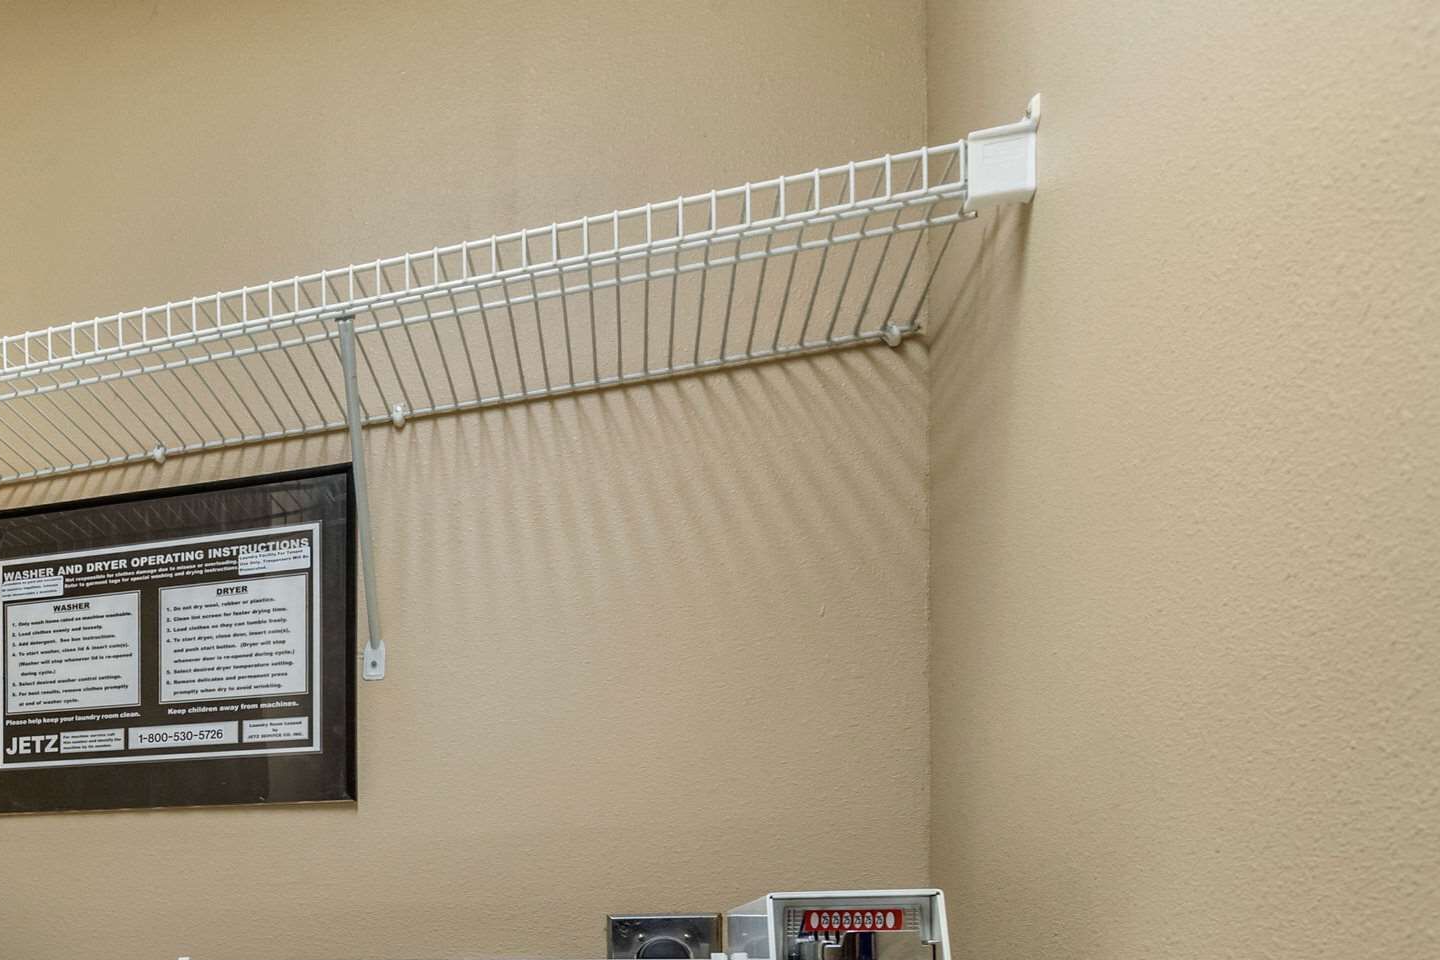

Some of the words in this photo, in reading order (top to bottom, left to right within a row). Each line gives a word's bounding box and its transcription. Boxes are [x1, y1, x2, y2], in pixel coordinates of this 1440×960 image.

[3, 567, 53, 582] WASHER
[57, 564, 82, 575] AND
[86, 558, 127, 572] DRYER
[131, 549, 203, 566] OPERATING
[208, 536, 308, 557] INSTRUCTIONS
[216, 585, 248, 595] DRYER
[52, 601, 90, 612] WASHER
[167, 707, 186, 715] Keep
[187, 705, 217, 713] children
[259, 699, 299, 708] machines.
[74, 713, 100, 721] laundry
[138, 729, 223, 743] 1-800-530-5726
[5, 734, 58, 755] JETZ
